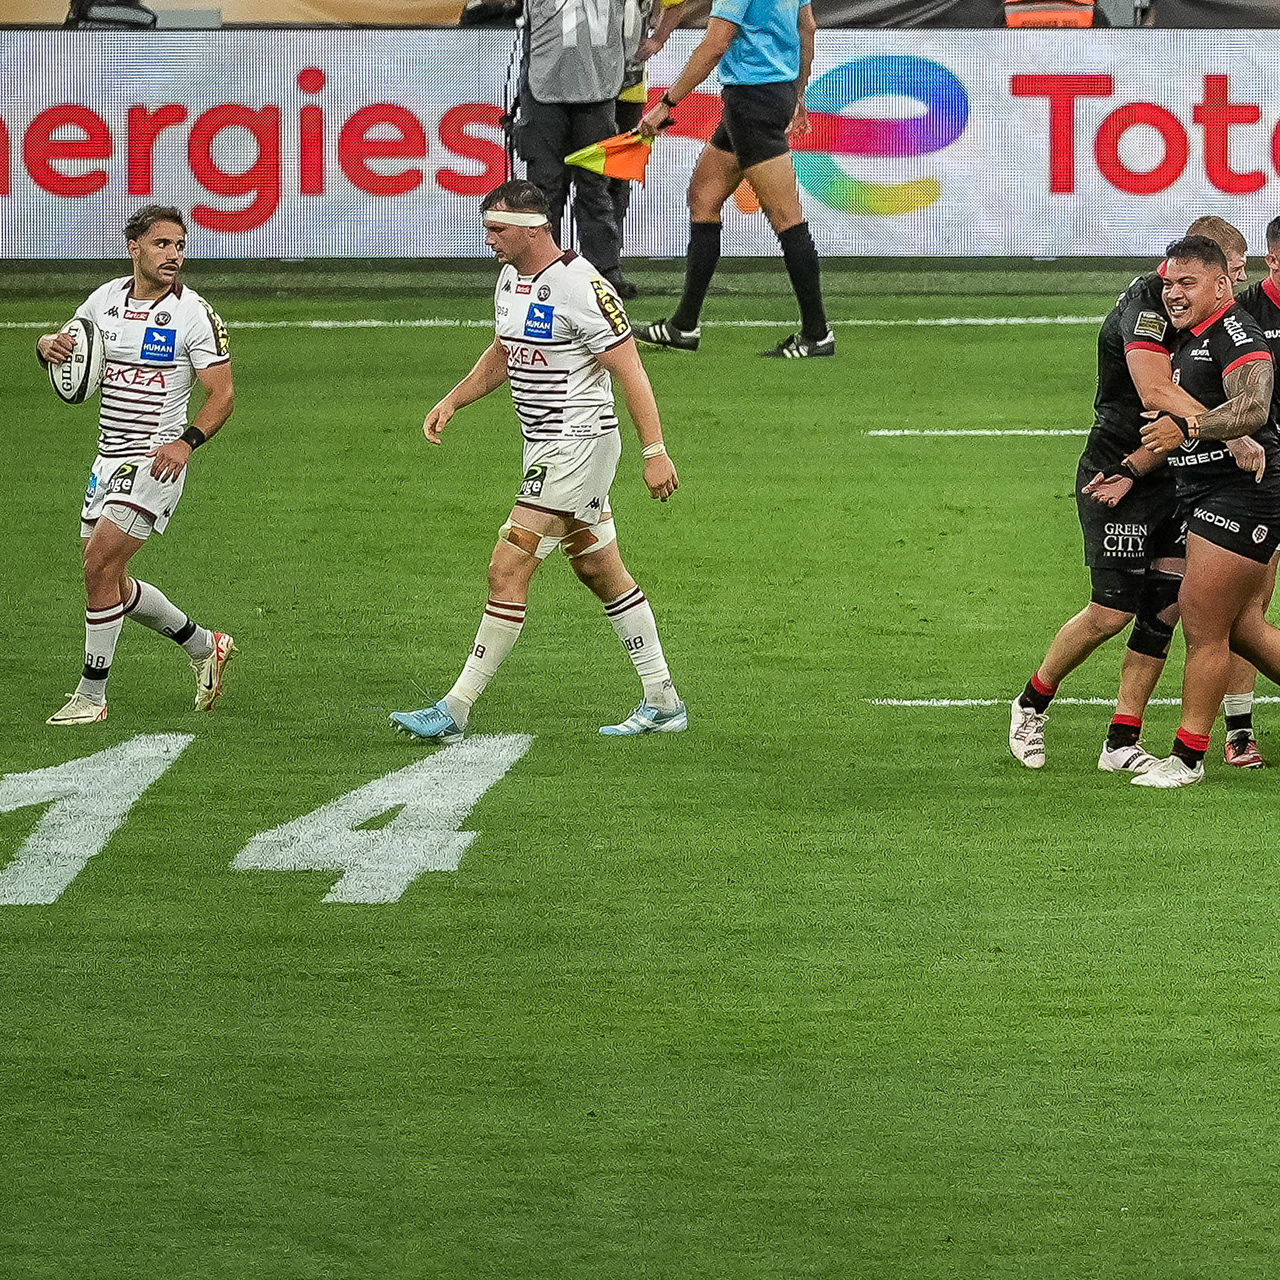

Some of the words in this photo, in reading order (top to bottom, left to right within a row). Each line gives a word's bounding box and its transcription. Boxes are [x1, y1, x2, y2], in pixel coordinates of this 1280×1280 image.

[525, 320, 551, 331] HUMAN
[143, 343, 173, 354] HUMAN
[104, 366, 166, 389] RKEA
[1104, 522, 1148, 536] GREEN
[1103, 535, 1145, 552] CITY
